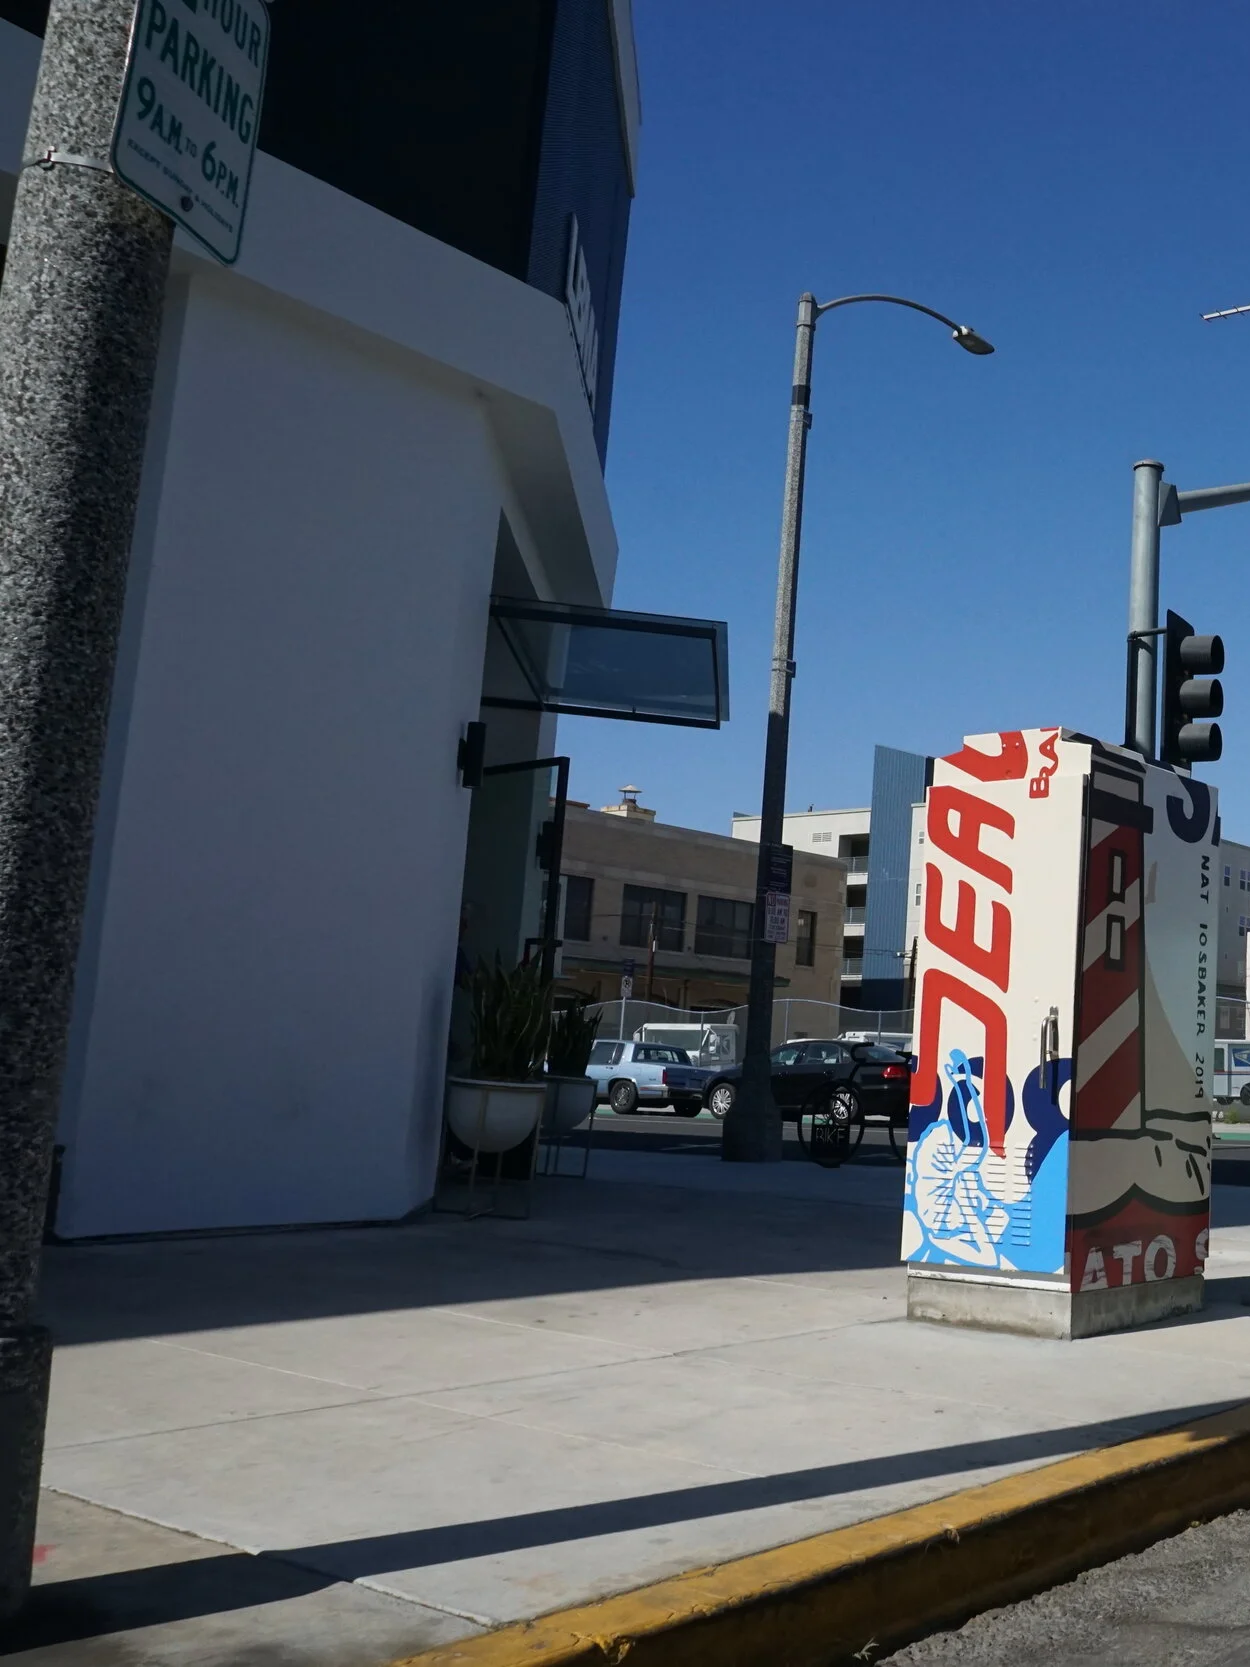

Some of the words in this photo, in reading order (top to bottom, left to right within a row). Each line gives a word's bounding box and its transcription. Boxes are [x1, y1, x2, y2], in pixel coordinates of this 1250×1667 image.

[145, 0, 254, 144] PARKING
[186, 137, 198, 158] TO
[1029, 727, 1060, 799] BRA
[1199, 855, 1210, 904] NAT
[1195, 922, 1209, 1037] IOSBAKER
[1195, 1052, 1206, 1099] 2019
